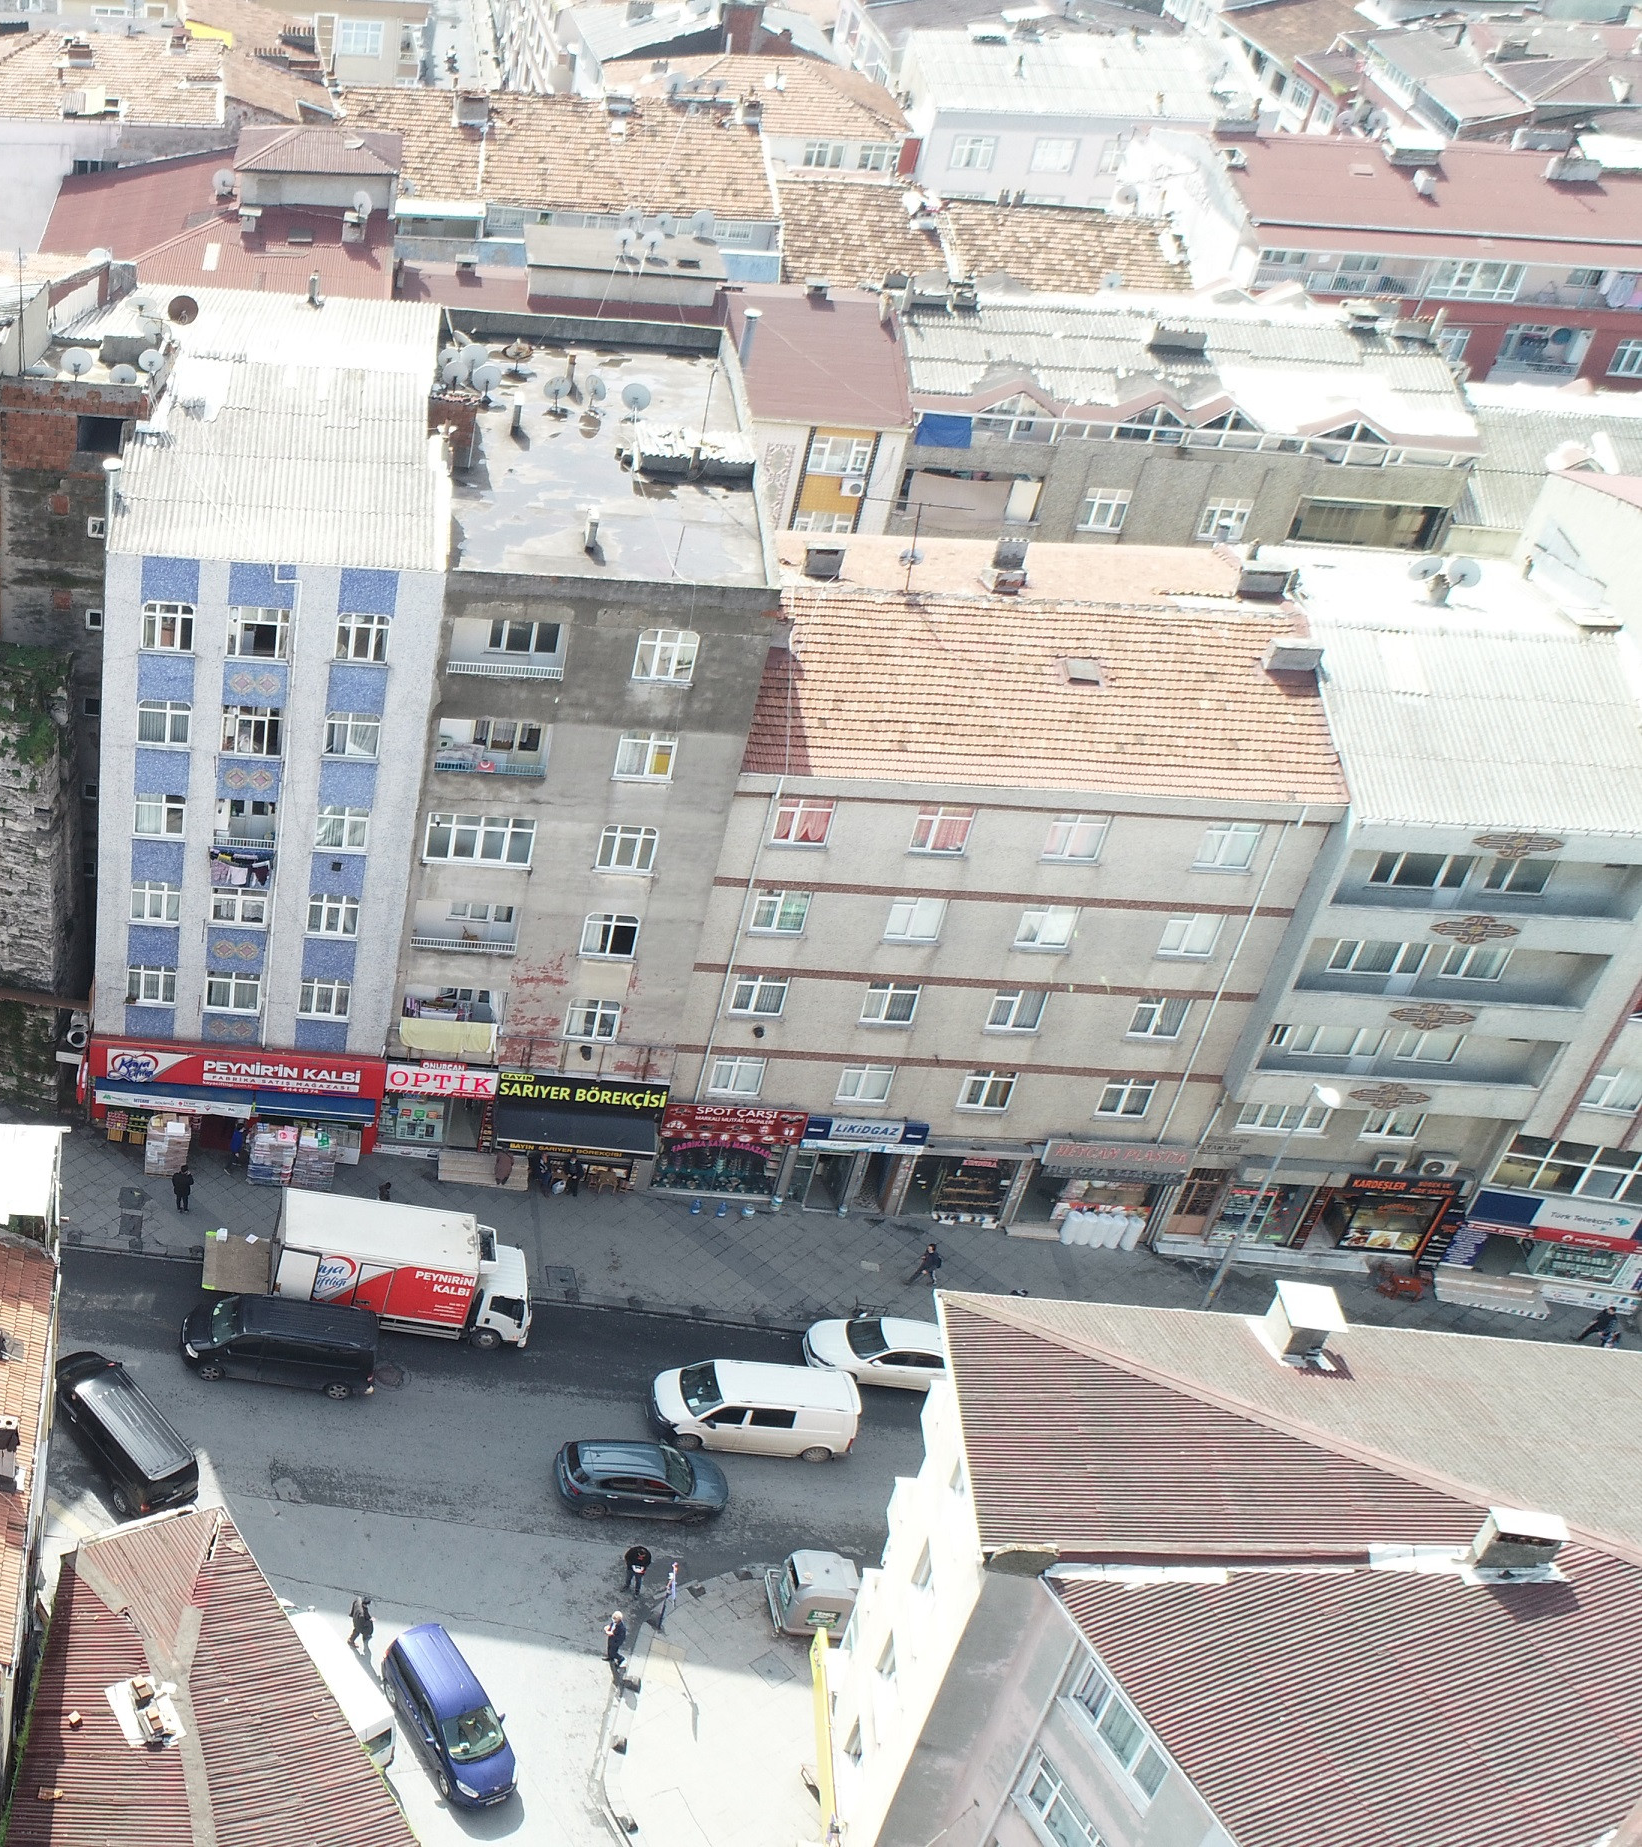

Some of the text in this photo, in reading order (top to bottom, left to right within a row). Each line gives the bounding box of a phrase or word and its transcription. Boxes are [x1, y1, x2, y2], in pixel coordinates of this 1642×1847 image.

[118, 1058, 151, 1075] Kaya
[303, 1069, 361, 1083] KALBİ
[390, 1071, 493, 1093] OPTİK
[503, 1073, 533, 1081] BAYIN
[212, 1075, 256, 1083] FABRİKA
[294, 1082, 351, 1091] MAĞAZASI
[499, 1083, 667, 1109] SARIYER BÖREKÇİSİ
[696, 1106, 778, 1119] SPOT ÇARŞI
[510, 1142, 534, 1150] BAYIN
[1352, 1180, 1407, 1191] KARDEŞLER
[1551, 1211, 1613, 1226] Türk Telekom
[318, 1264, 345, 1276] aya
[433, 1284, 470, 1297] KALBİ
